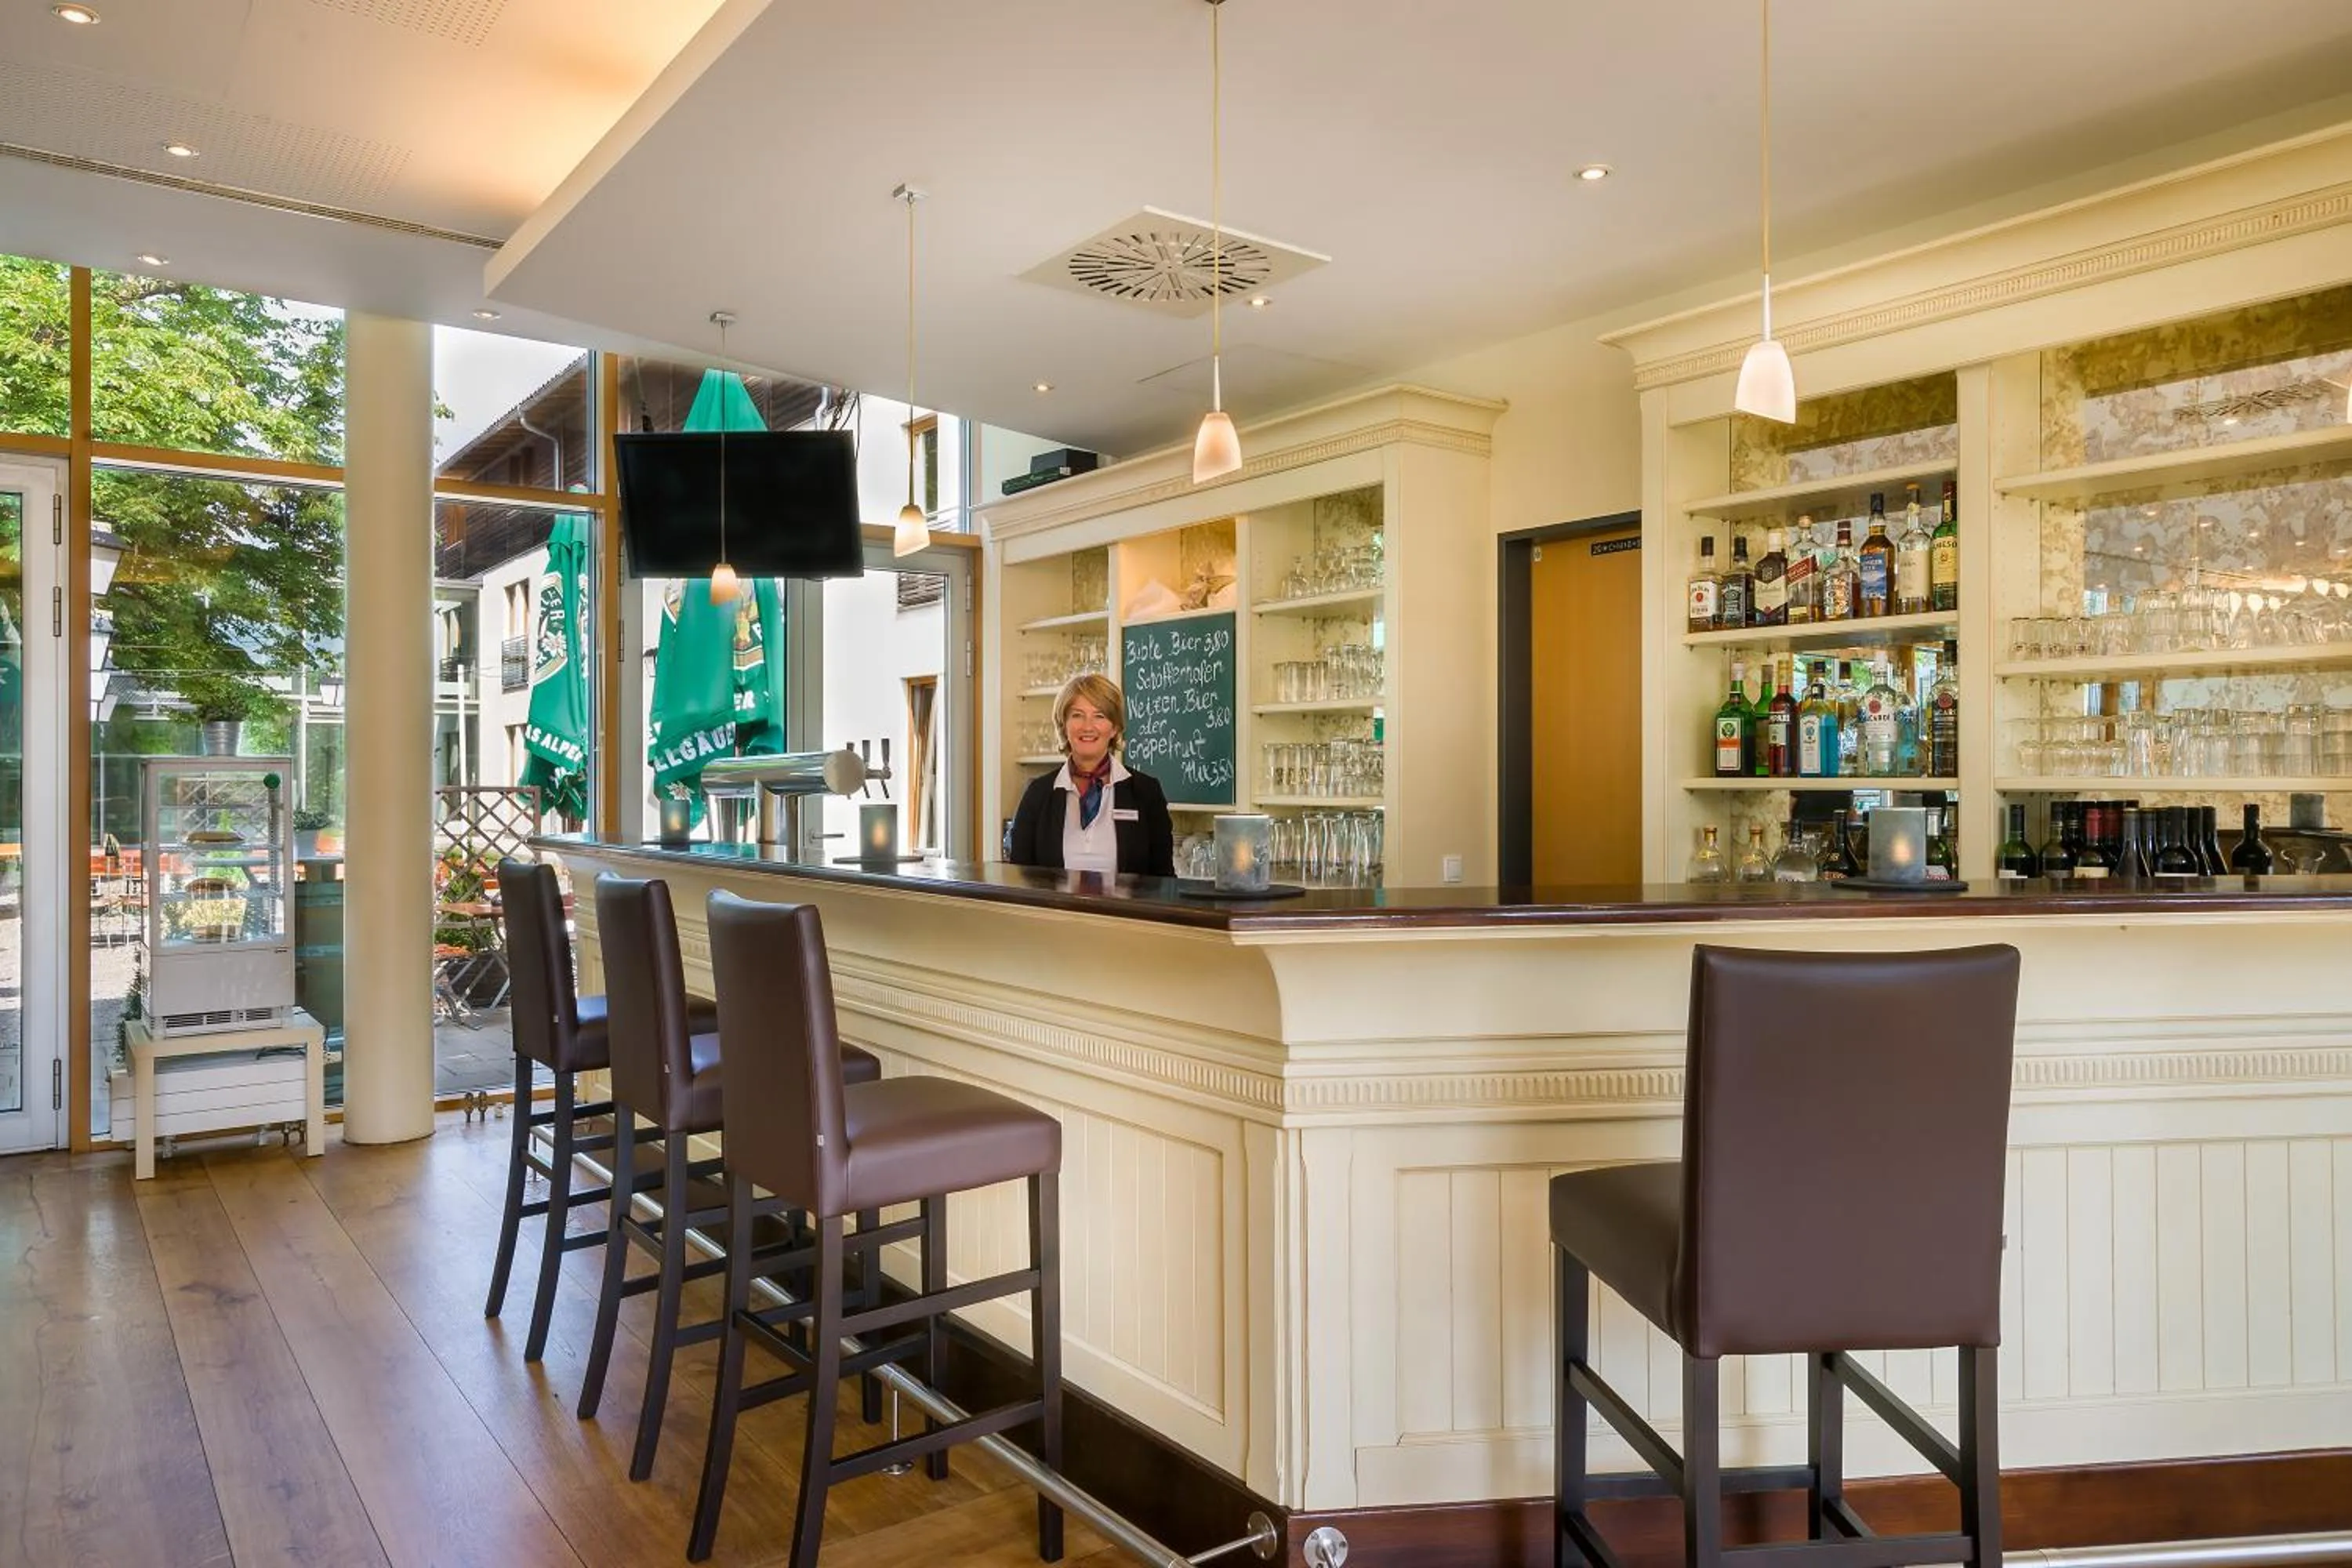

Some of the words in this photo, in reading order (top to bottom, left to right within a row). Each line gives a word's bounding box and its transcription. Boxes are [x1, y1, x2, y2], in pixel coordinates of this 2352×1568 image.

[1168, 631, 1202, 656] Bier
[1203, 630, 1229, 657] 3,80
[1127, 695, 1179, 720] Weizen
[1181, 688, 1218, 713] Bier
[1139, 716, 1167, 735] oder
[1205, 706, 1231, 728] 3,80
